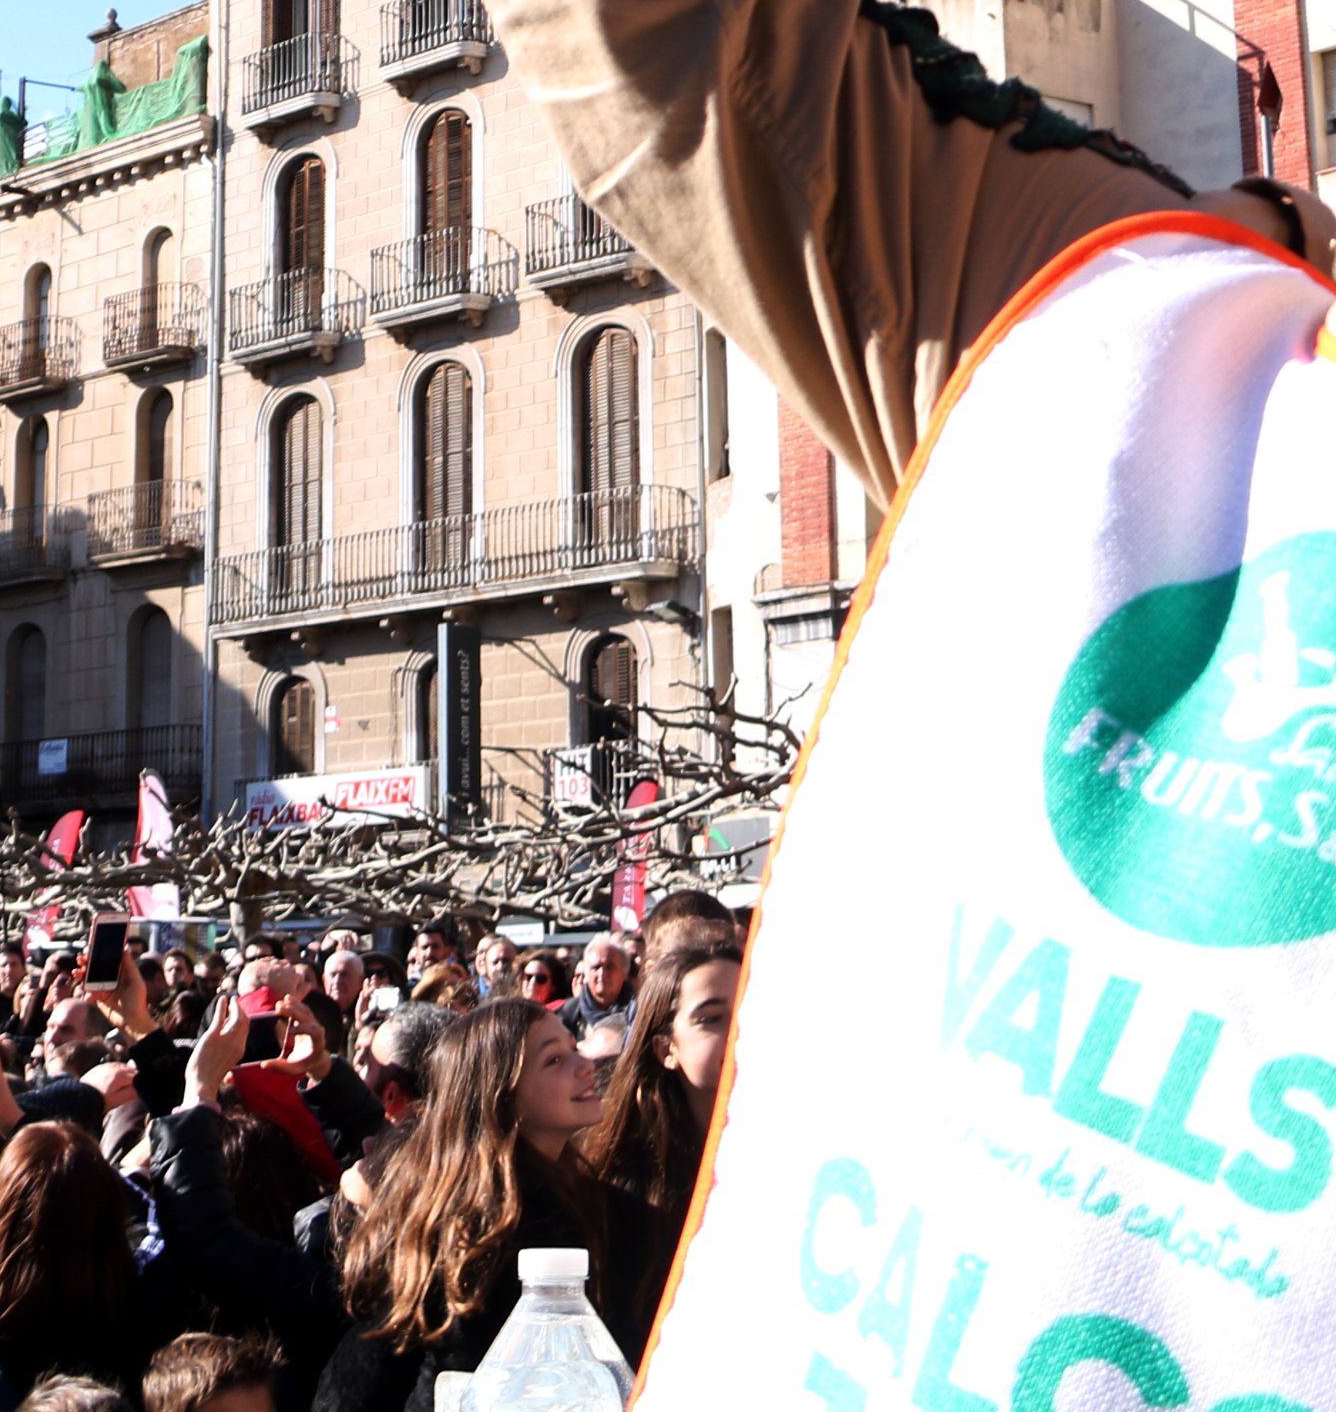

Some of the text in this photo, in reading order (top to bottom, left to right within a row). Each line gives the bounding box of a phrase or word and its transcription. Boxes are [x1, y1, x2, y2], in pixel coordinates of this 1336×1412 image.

[457, 649, 471, 695] sents?
[459, 697, 471, 713] et
[460, 716, 471, 746] com
[559, 776, 589, 798] 103
